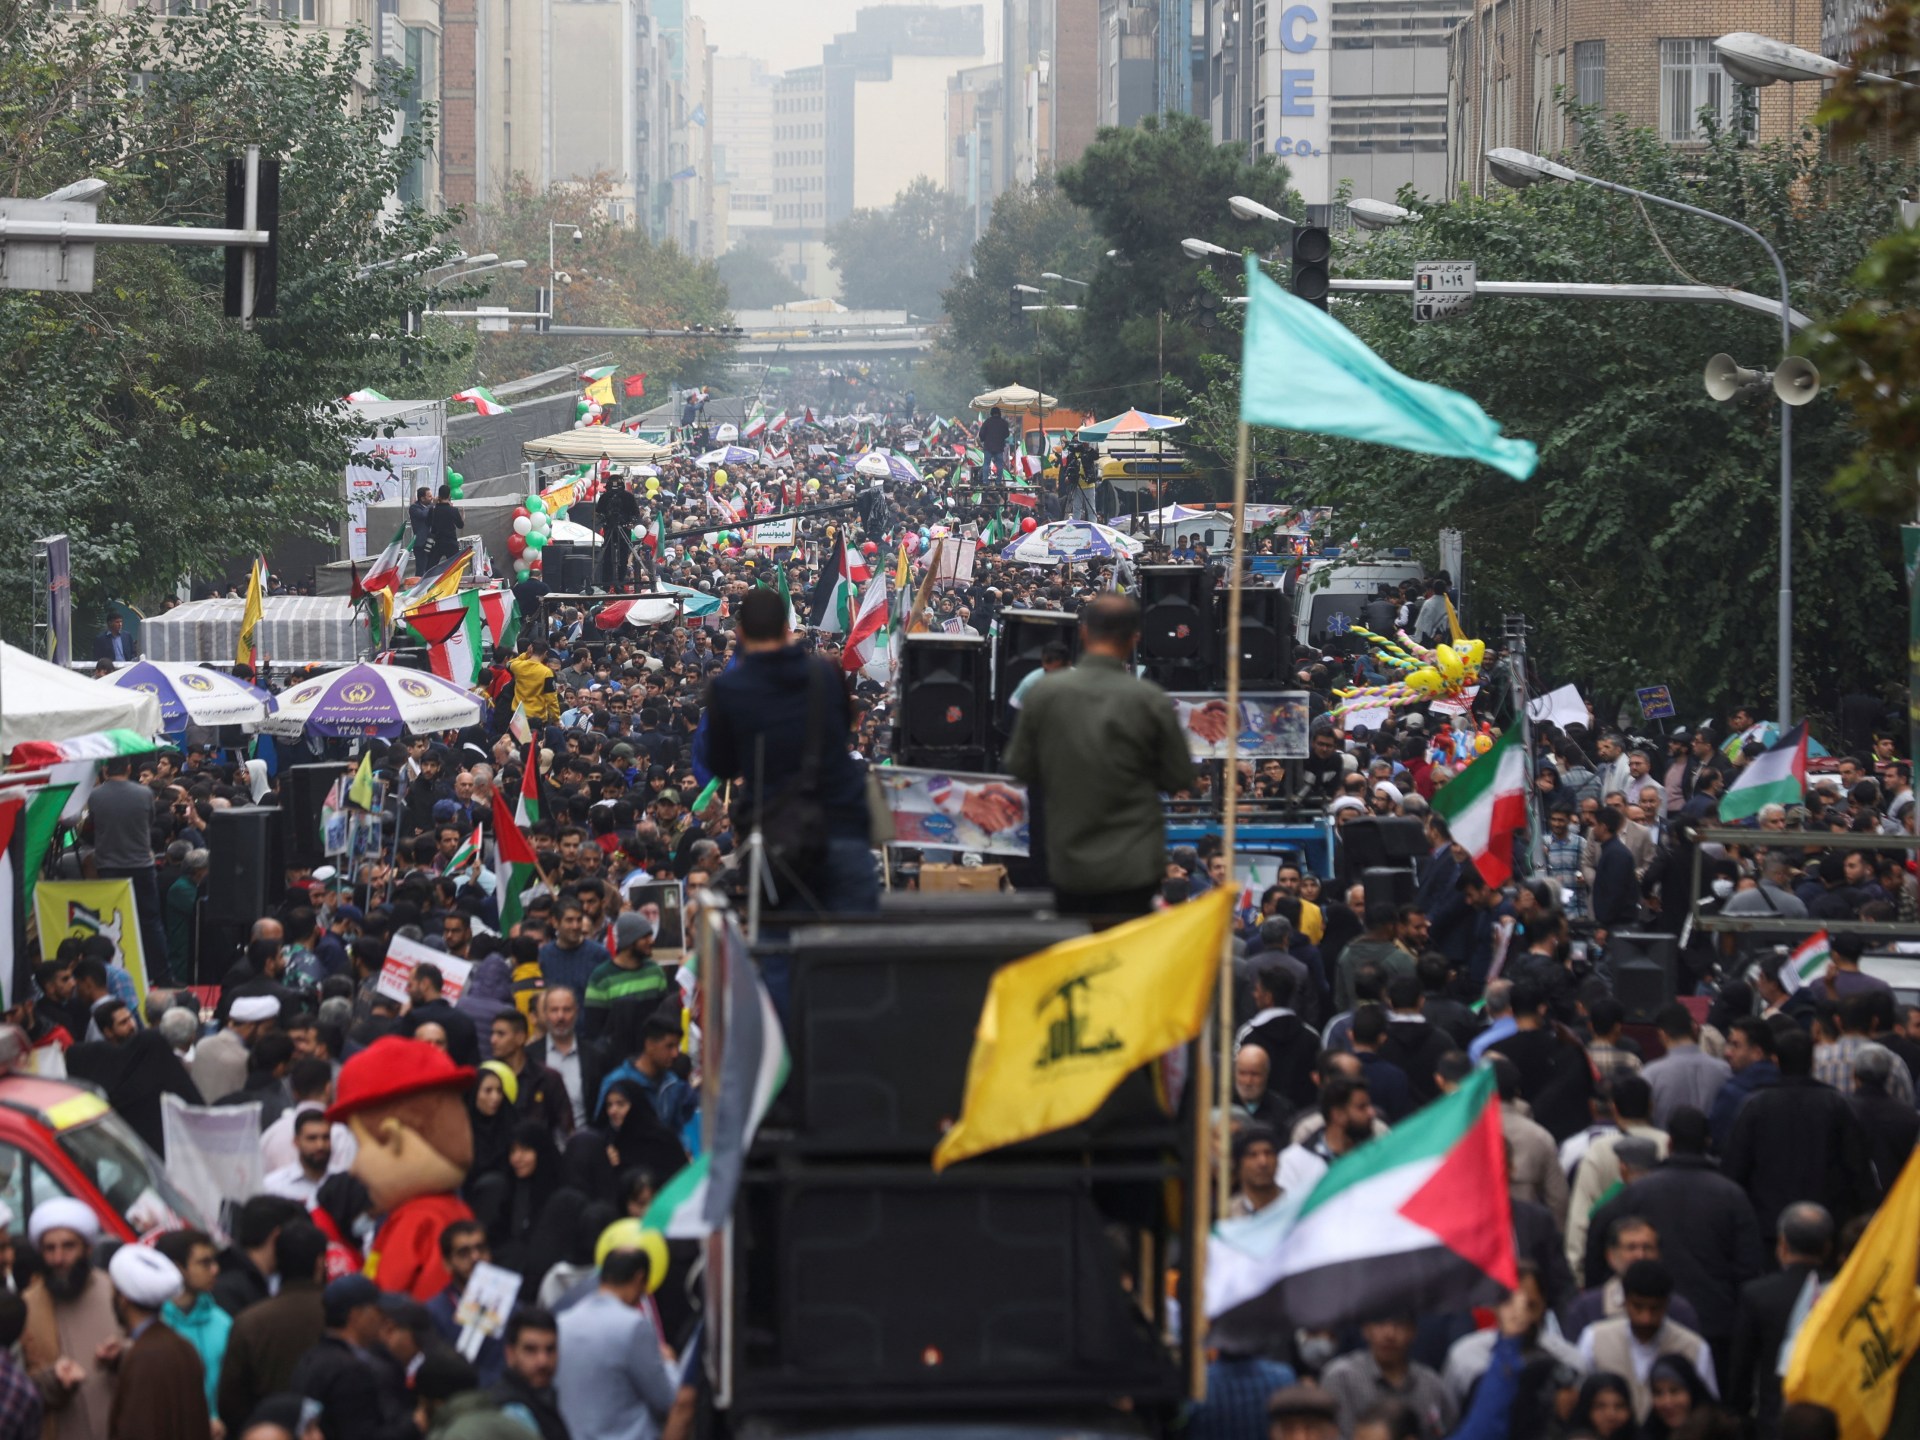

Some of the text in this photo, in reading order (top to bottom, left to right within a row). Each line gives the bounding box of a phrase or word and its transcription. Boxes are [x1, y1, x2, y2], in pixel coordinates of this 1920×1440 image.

[1418, 264, 1445, 273] راهنمایی
[1446, 264, 1462, 273] چراغ
[1440, 274, 1464, 287] ۱۰۱۹
[1417, 295, 1436, 304] خرابی
[1437, 295, 1459, 304] گزارش
[757, 530, 792, 539] صهیونیسم
[355, 716, 377, 724] پرداخت
[377, 716, 394, 724] سامانه
